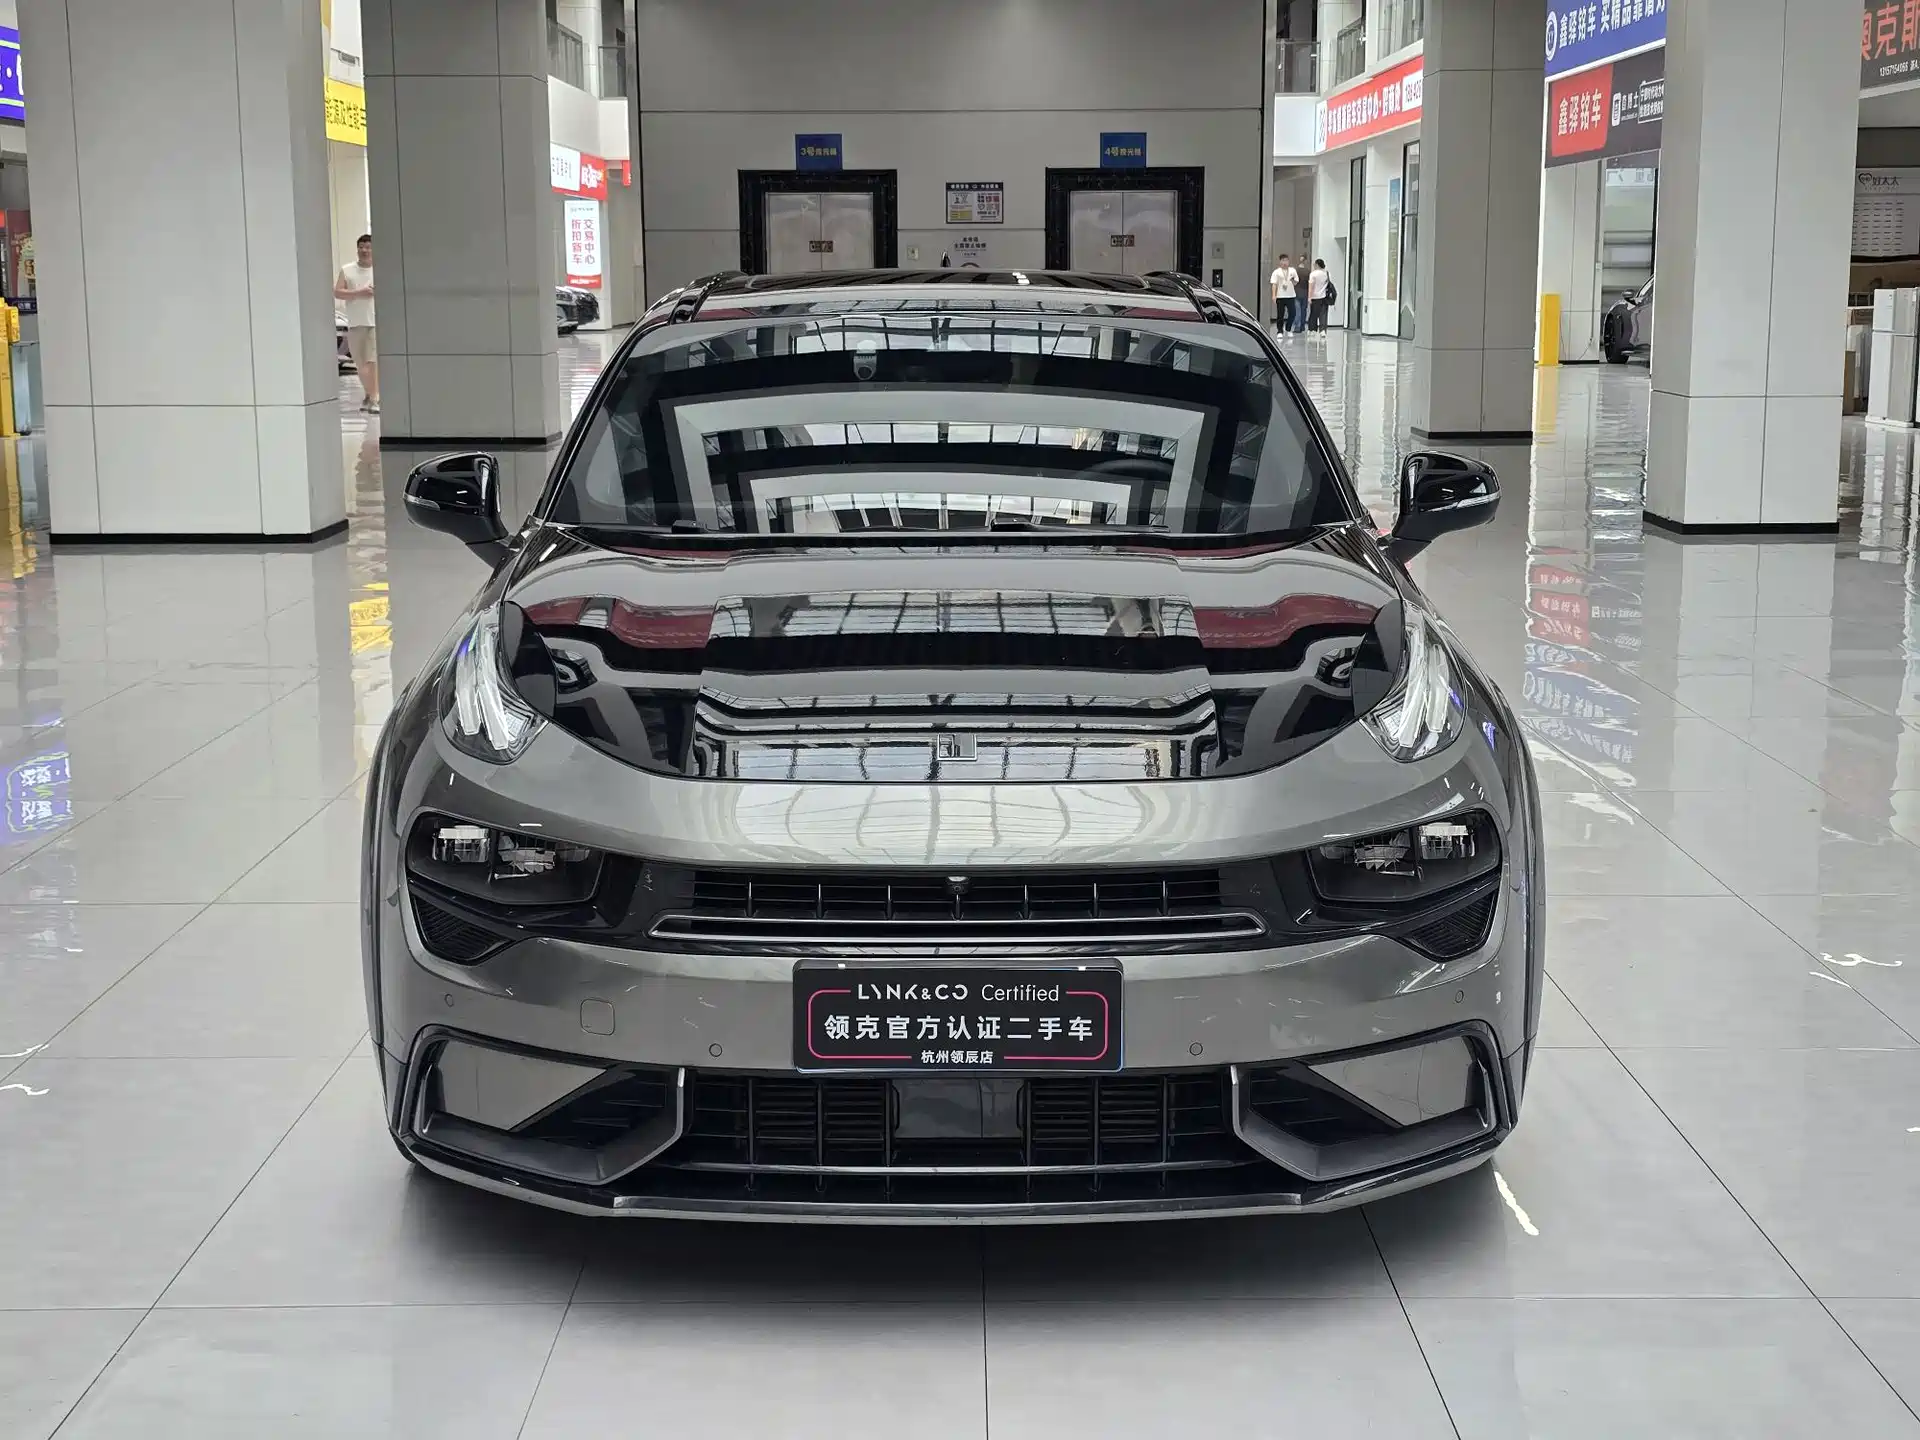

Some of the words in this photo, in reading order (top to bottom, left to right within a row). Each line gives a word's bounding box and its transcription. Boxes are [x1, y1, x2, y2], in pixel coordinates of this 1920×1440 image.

[583, 218, 596, 265] 交易中心
[981, 984, 1059, 1001] Certified
[824, 1015, 1093, 1041] 领克官方认证二手车
[921, 1050, 994, 1064] 杭州领辰店
